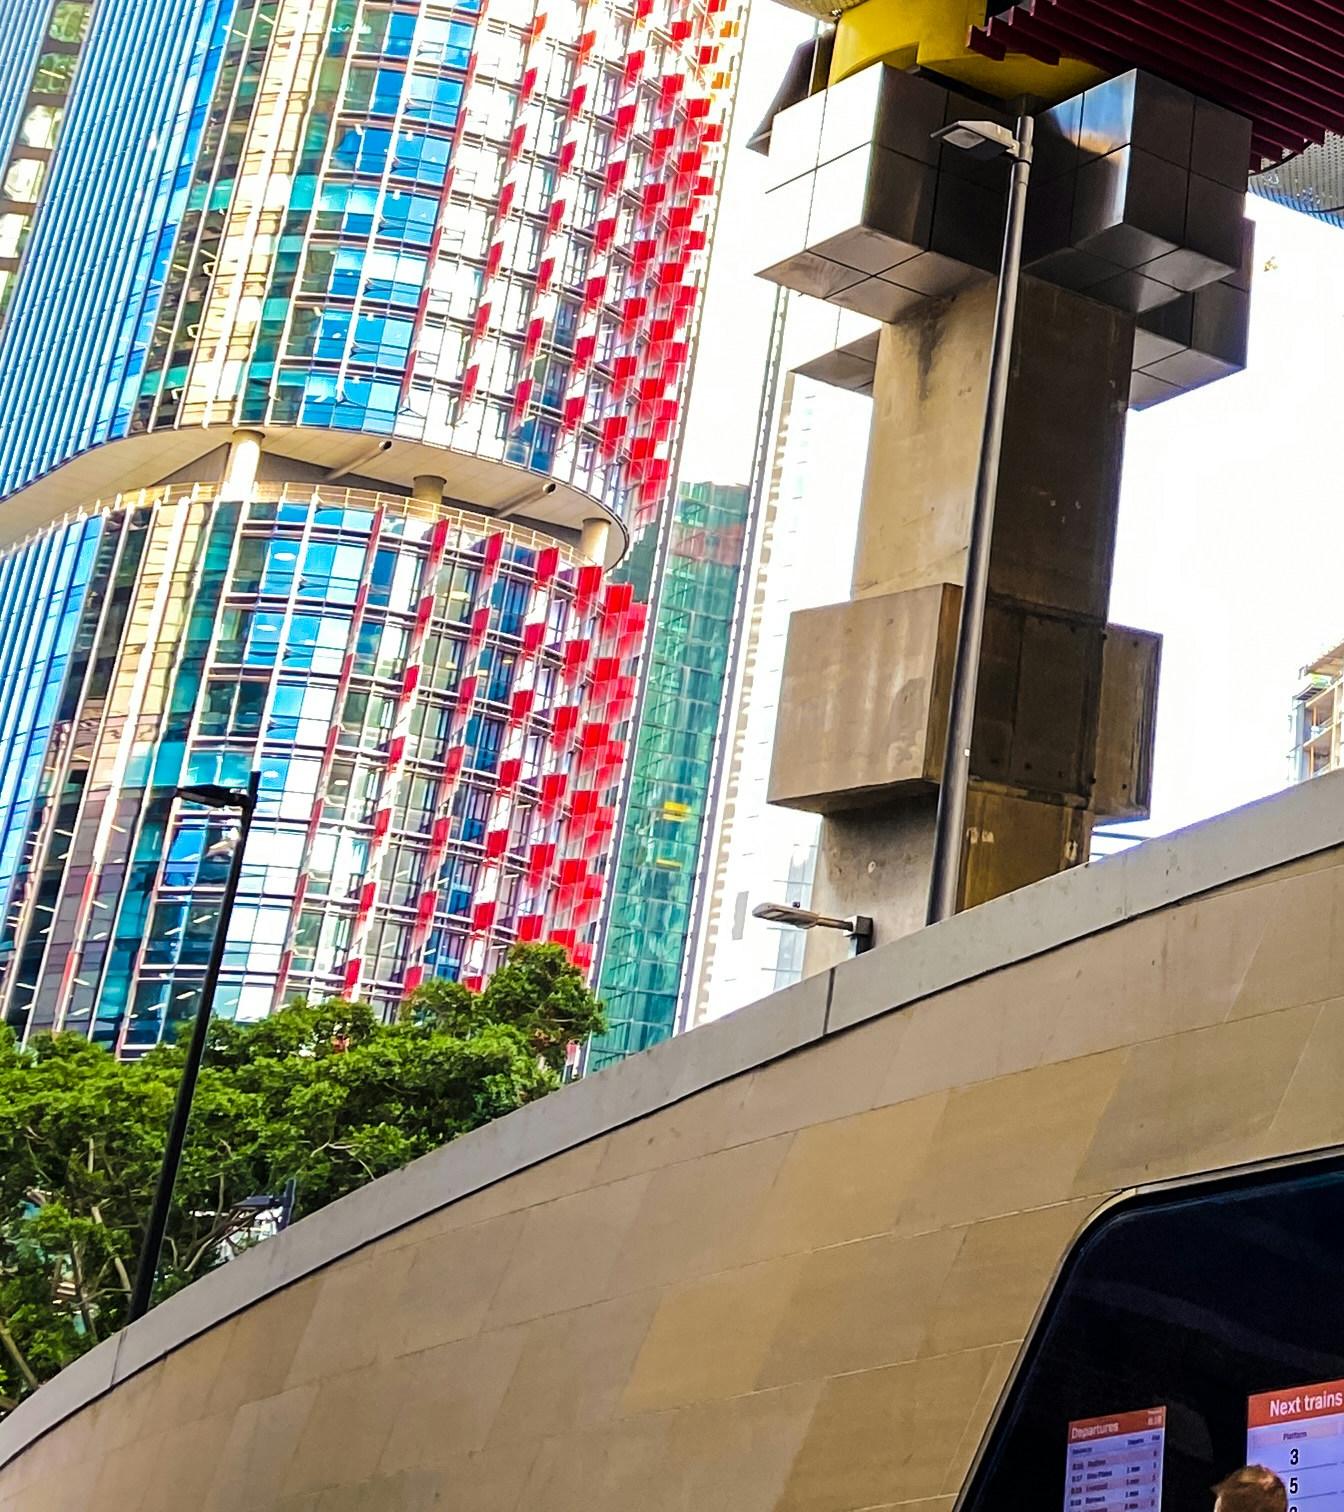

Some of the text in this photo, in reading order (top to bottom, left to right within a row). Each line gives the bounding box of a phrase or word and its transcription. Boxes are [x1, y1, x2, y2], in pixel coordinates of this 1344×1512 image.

[1269, 1397, 1301, 1417] Next
[1304, 1391, 1343, 1411] trains
[1071, 1422, 1119, 1439] Departures
[1290, 1448, 1299, 1465] 3
[1289, 1477, 1298, 1494] 5
